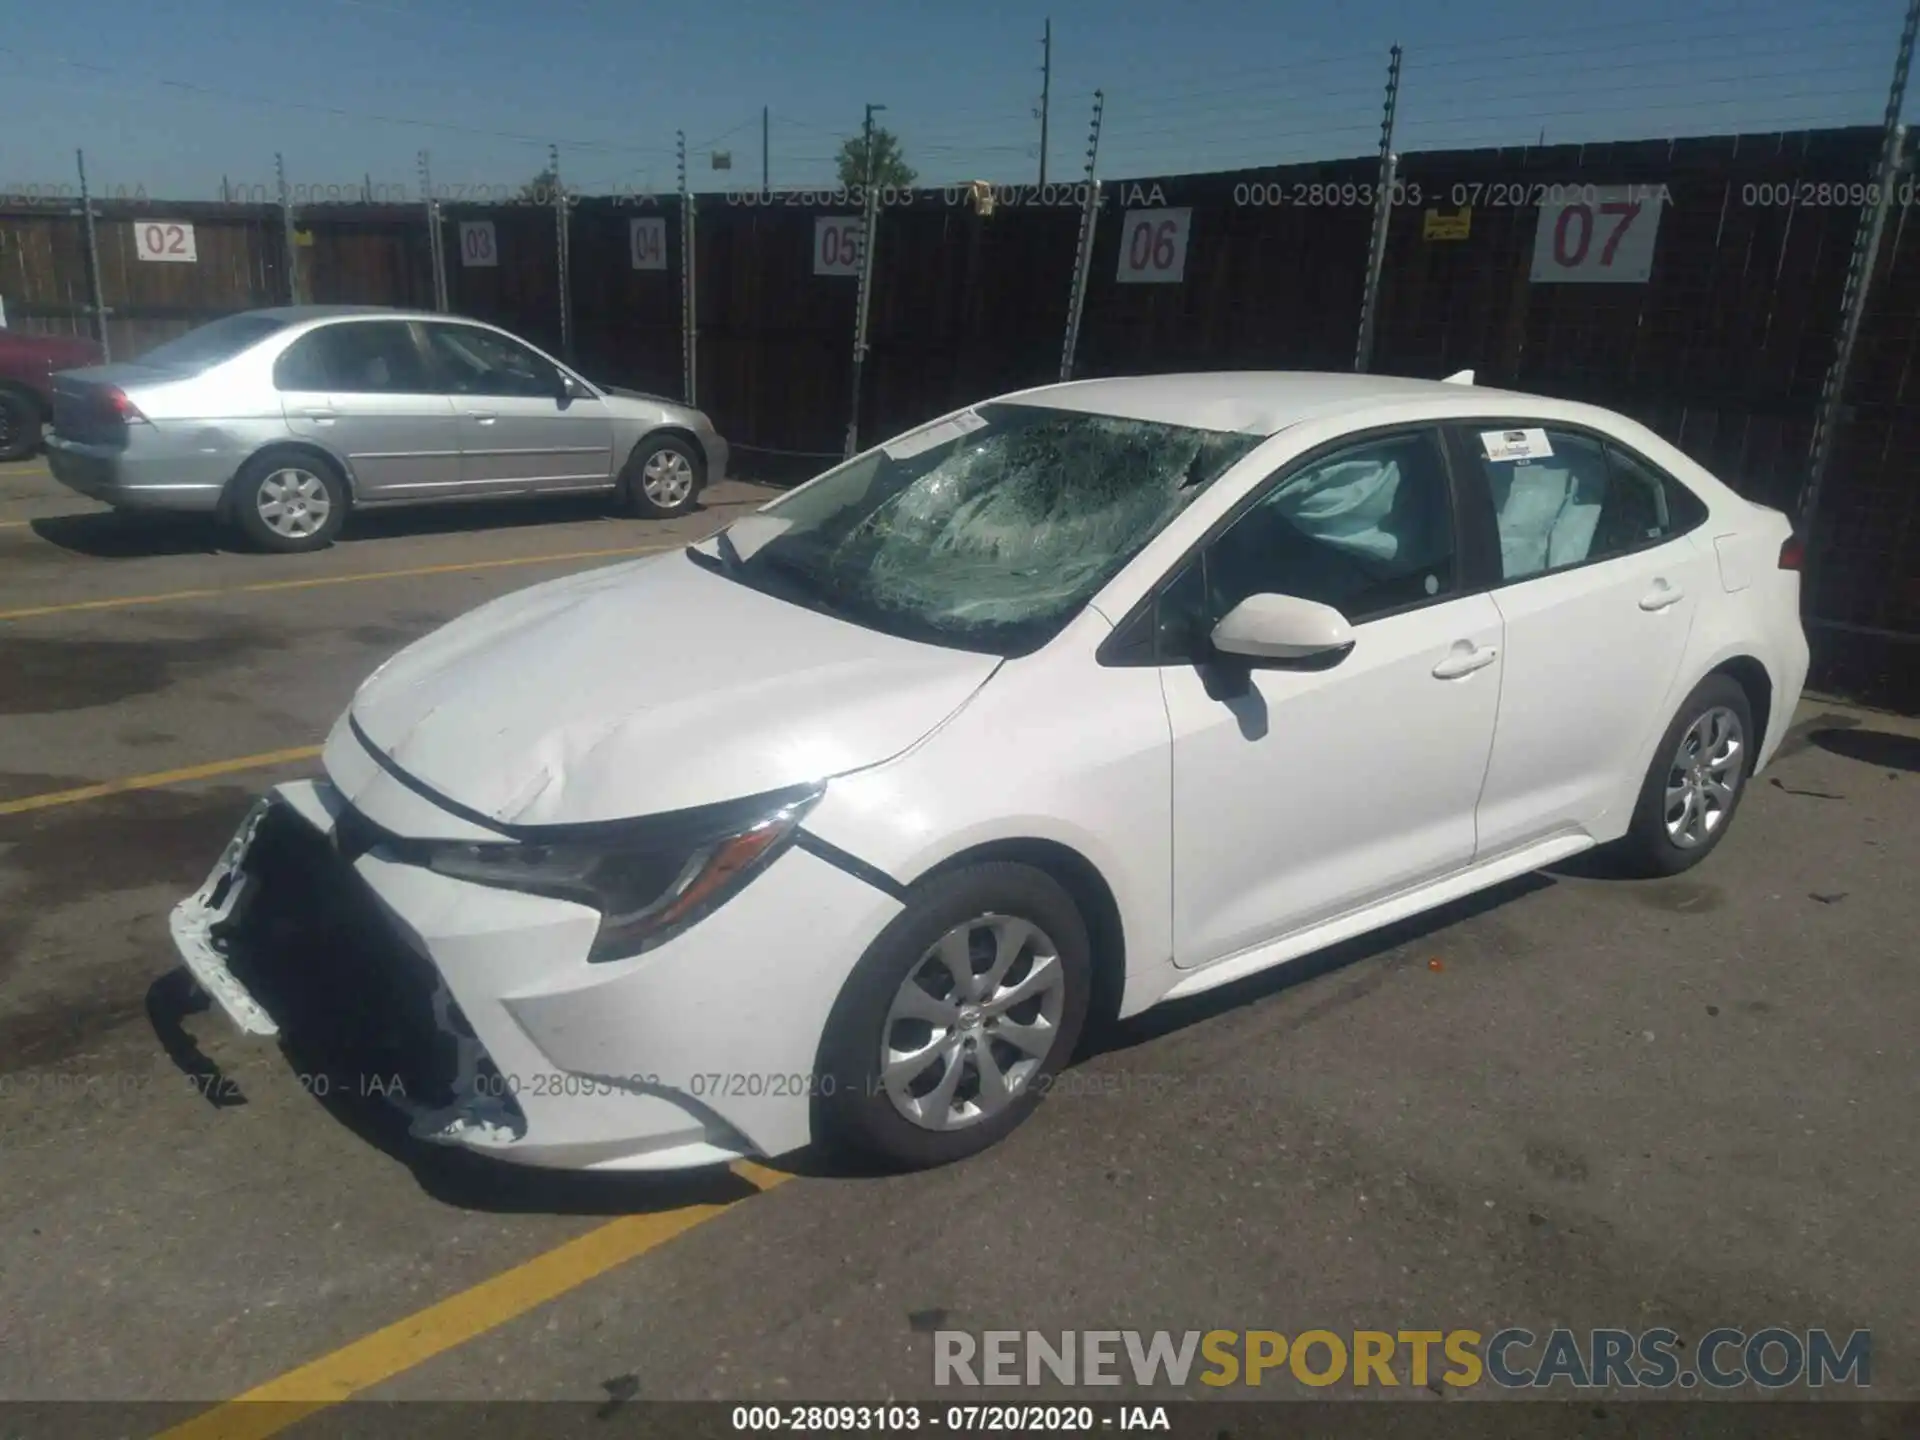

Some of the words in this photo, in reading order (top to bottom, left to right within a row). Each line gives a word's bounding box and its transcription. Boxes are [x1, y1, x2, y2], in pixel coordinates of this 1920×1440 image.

[145, 225, 187, 254] 02
[466, 227, 492, 260] 03
[636, 226, 660, 262] 04
[822, 225, 859, 267] 05
[1129, 219, 1178, 271] 06
[1553, 202, 1641, 268] 07
